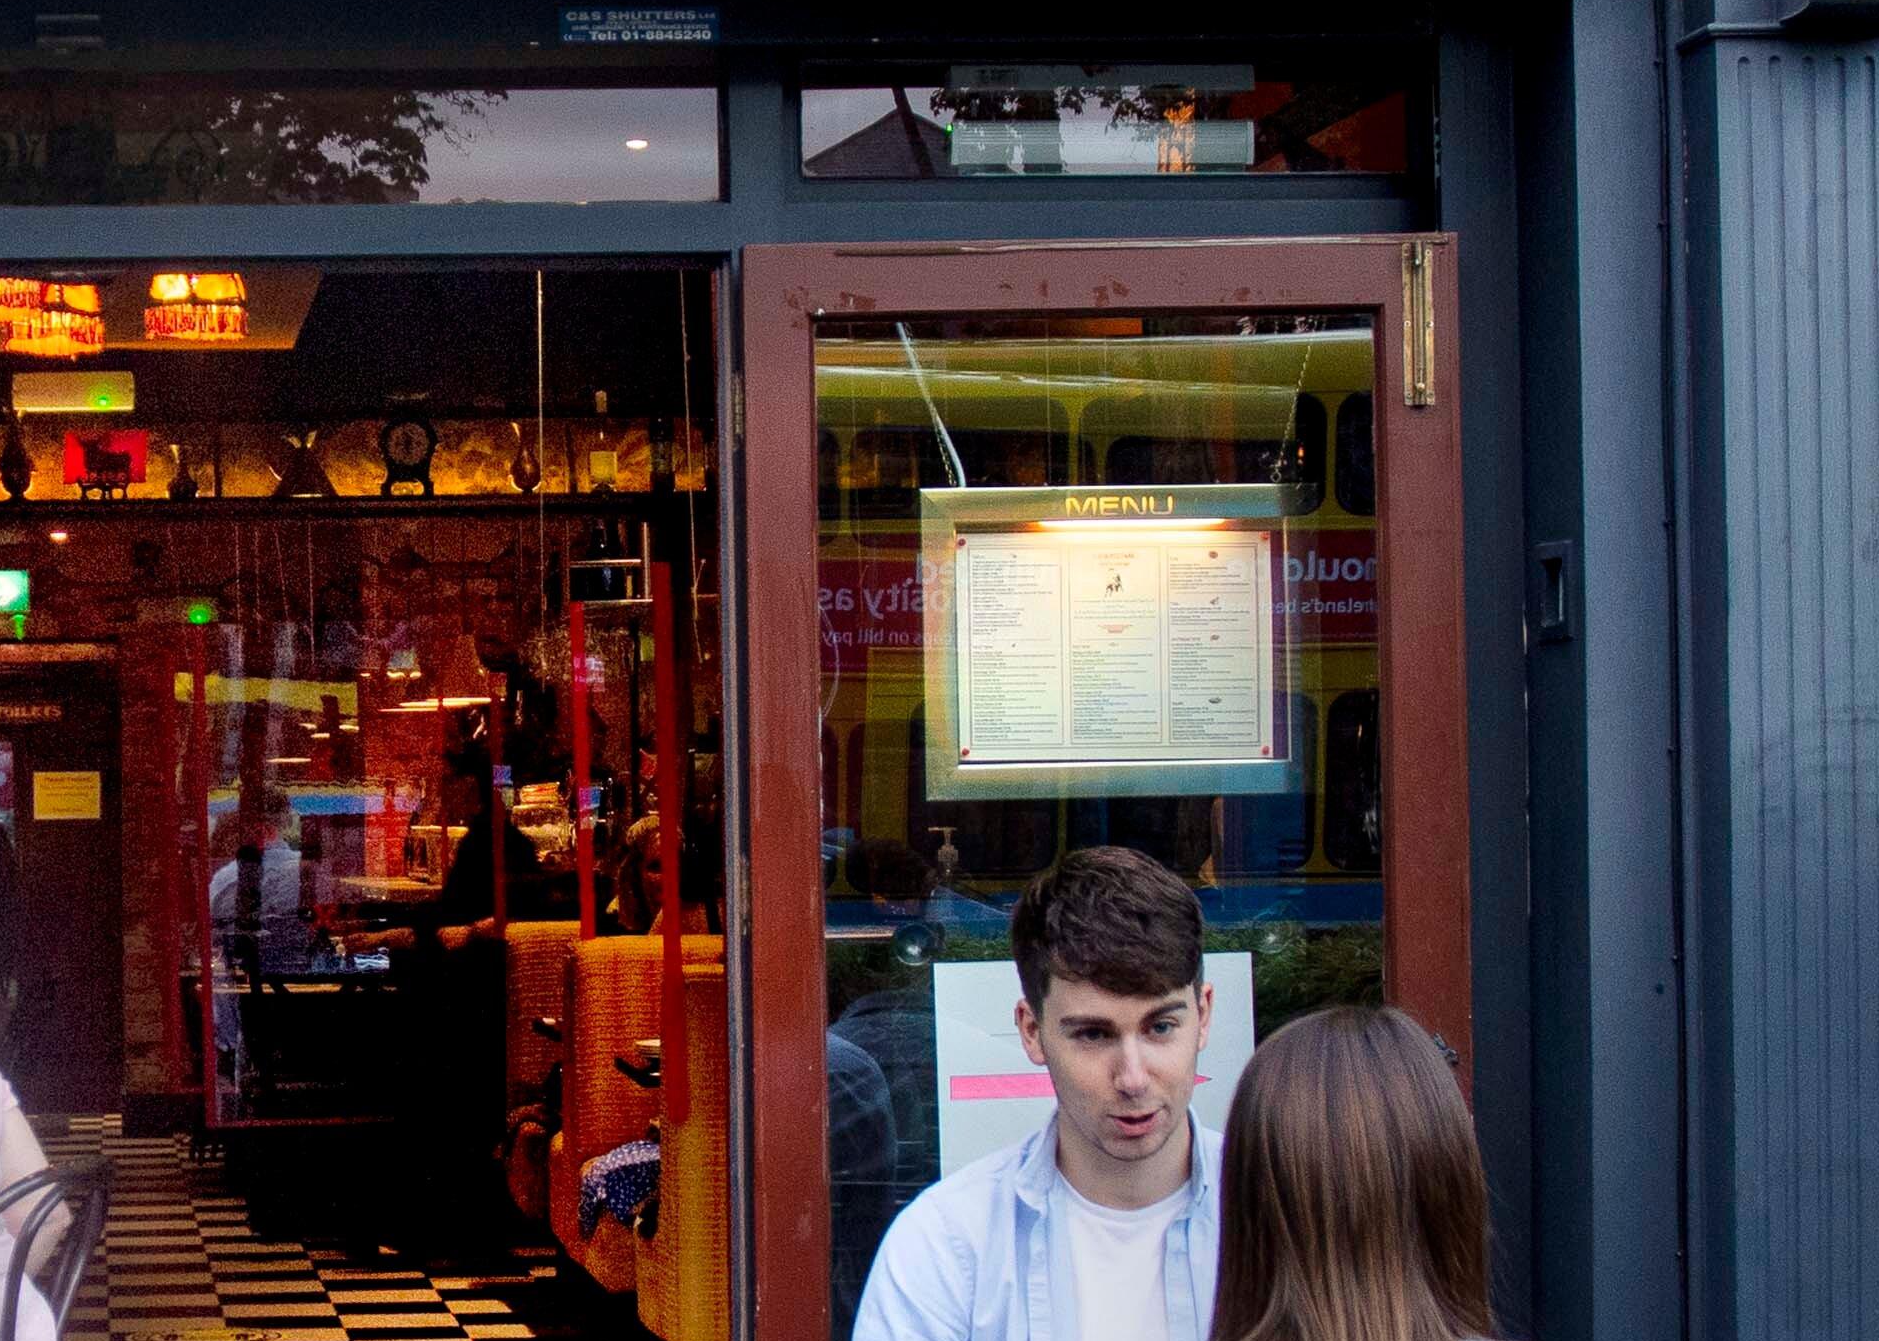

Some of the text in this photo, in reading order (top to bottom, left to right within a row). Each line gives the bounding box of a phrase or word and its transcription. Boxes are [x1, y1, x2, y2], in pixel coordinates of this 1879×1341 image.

[606, 10, 697, 21] SHUTTERS
[589, 30, 617, 41] Tel:
[1065, 495, 1175, 517] MENU
